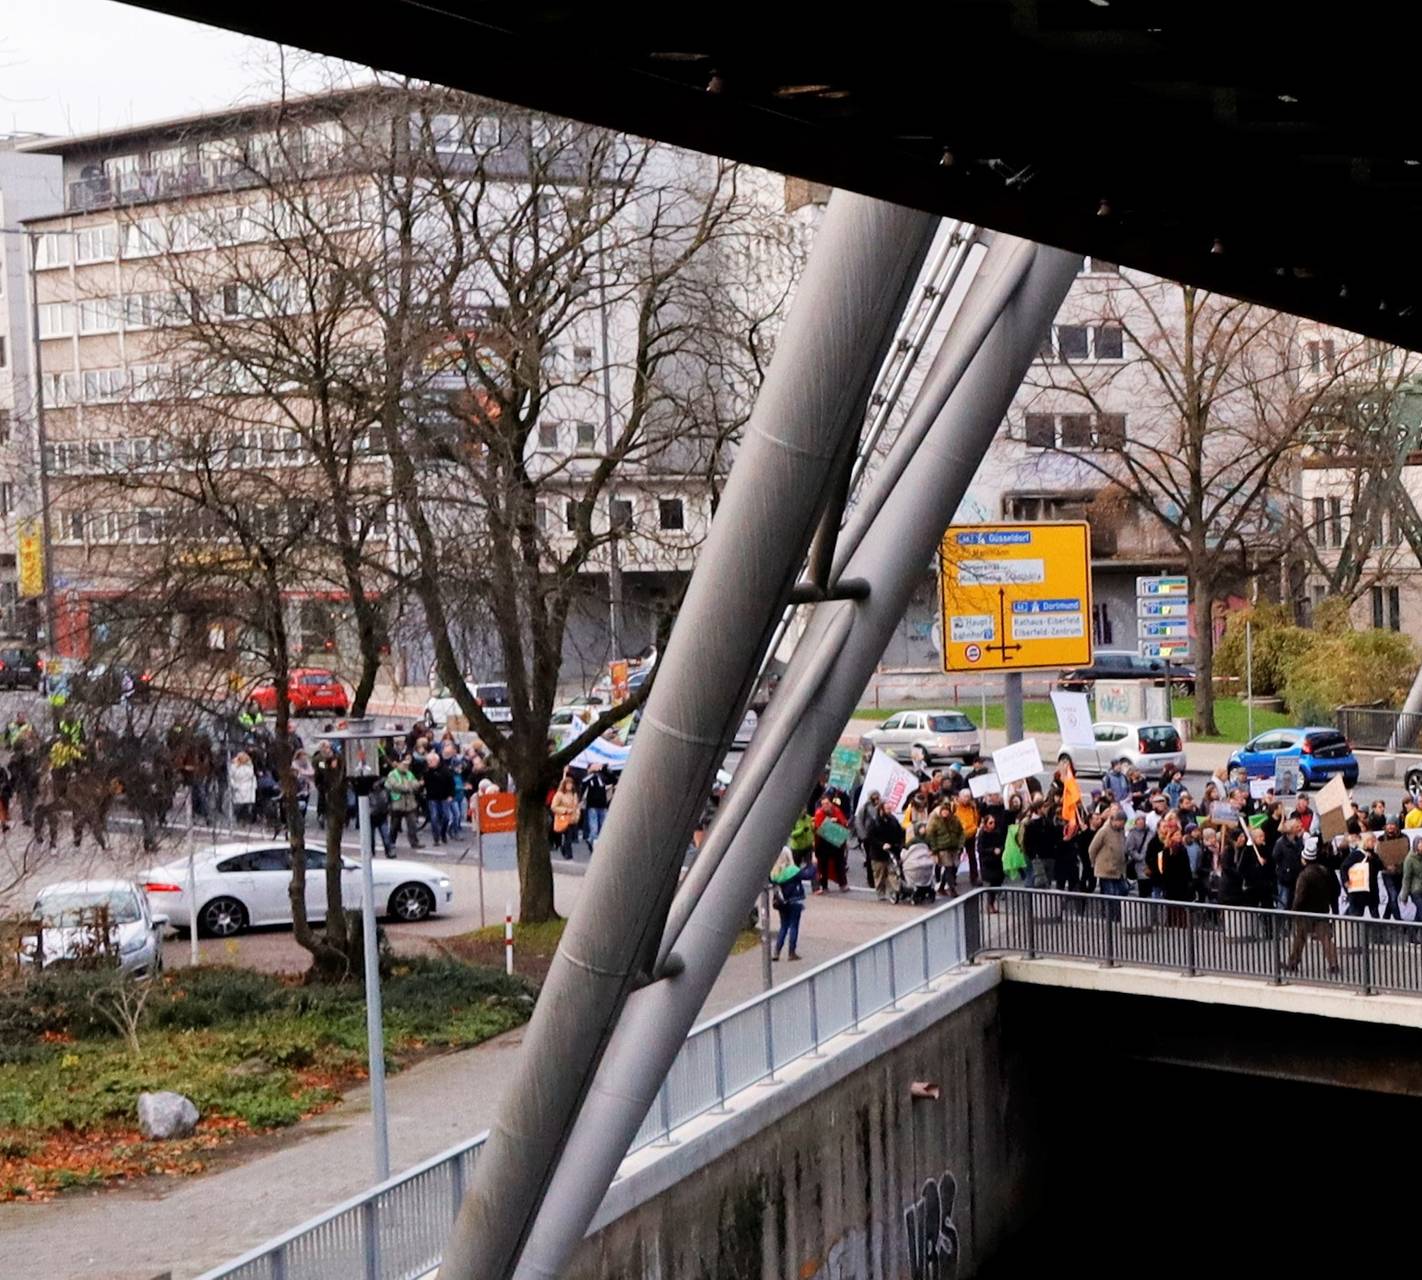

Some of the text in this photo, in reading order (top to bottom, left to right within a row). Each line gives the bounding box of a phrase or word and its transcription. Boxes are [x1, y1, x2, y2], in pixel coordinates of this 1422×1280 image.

[988, 532, 1030, 543] Düsseldorf
[1043, 600, 1080, 611] Dortmund
[1014, 627, 1081, 637] Elberfeld-Zentrum
